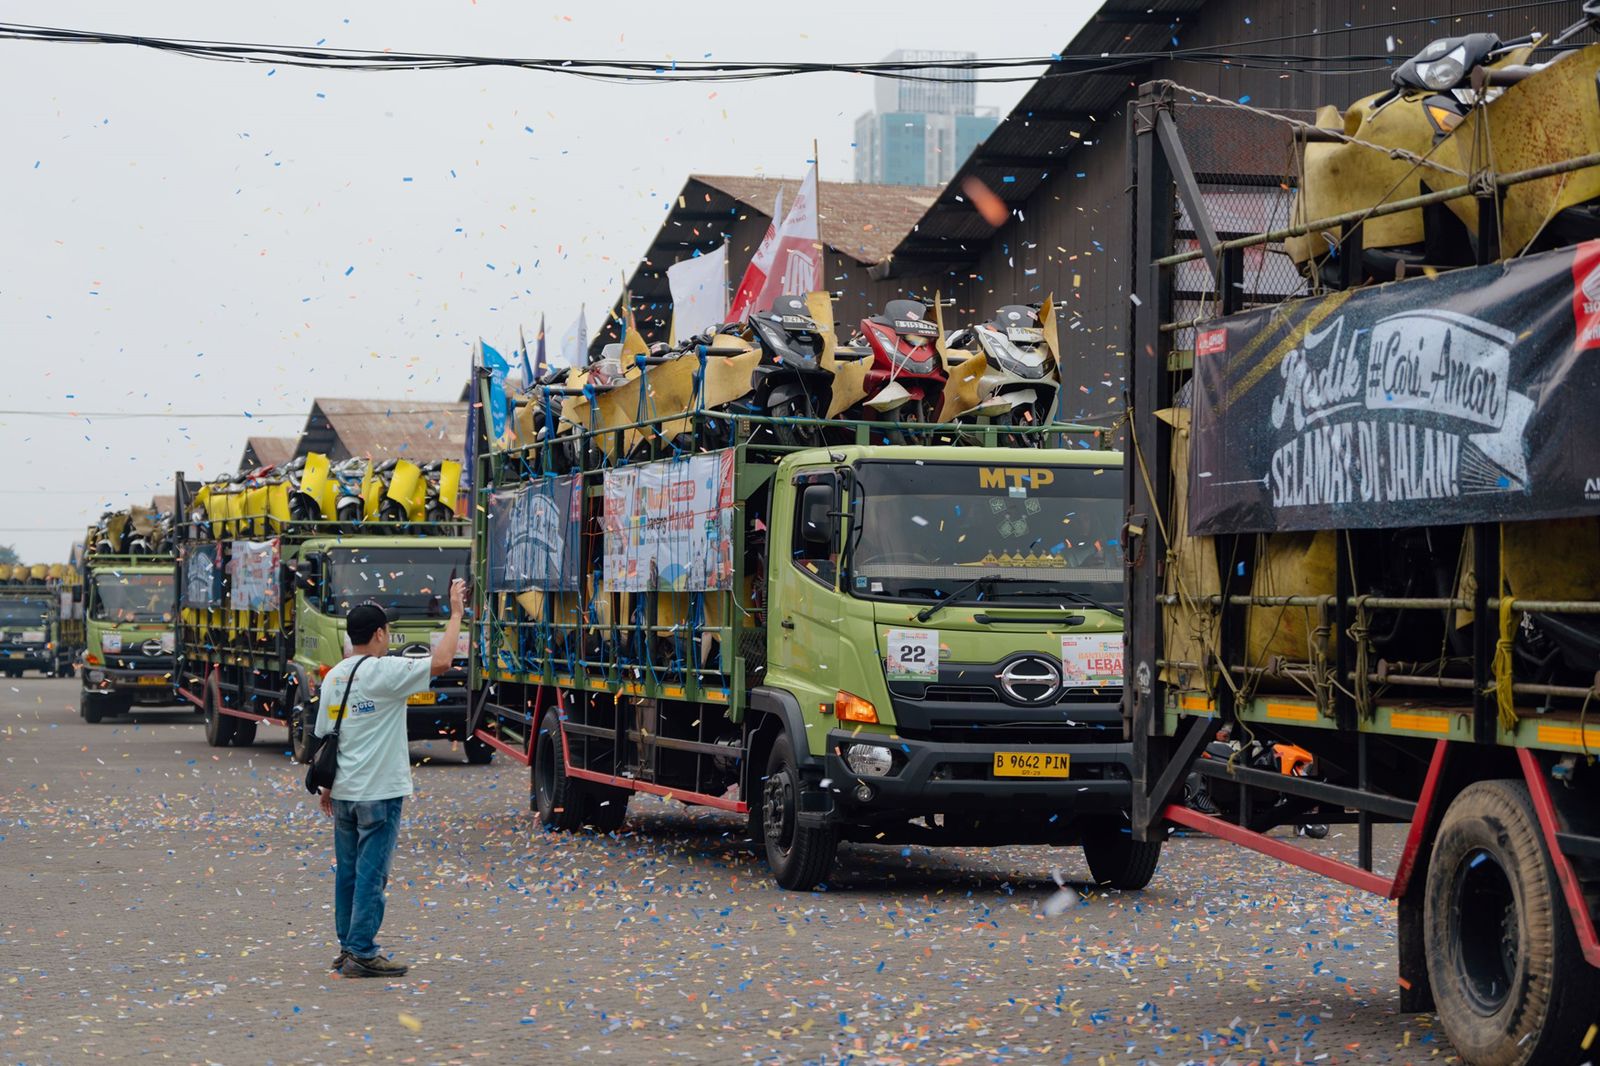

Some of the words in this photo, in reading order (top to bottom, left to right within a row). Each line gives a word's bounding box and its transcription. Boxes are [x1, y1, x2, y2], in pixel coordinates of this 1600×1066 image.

[1368, 328, 1500, 420] #Cari_Aman
[1272, 422, 1353, 508] SELAMAT
[1358, 420, 1381, 502] DI
[1386, 421, 1460, 502] JALAN!
[979, 467, 1054, 489] MTP
[900, 645, 926, 662] 22
[997, 755, 1004, 768] B
[1010, 755, 1040, 769] 9642
[1045, 756, 1068, 769] PIN
